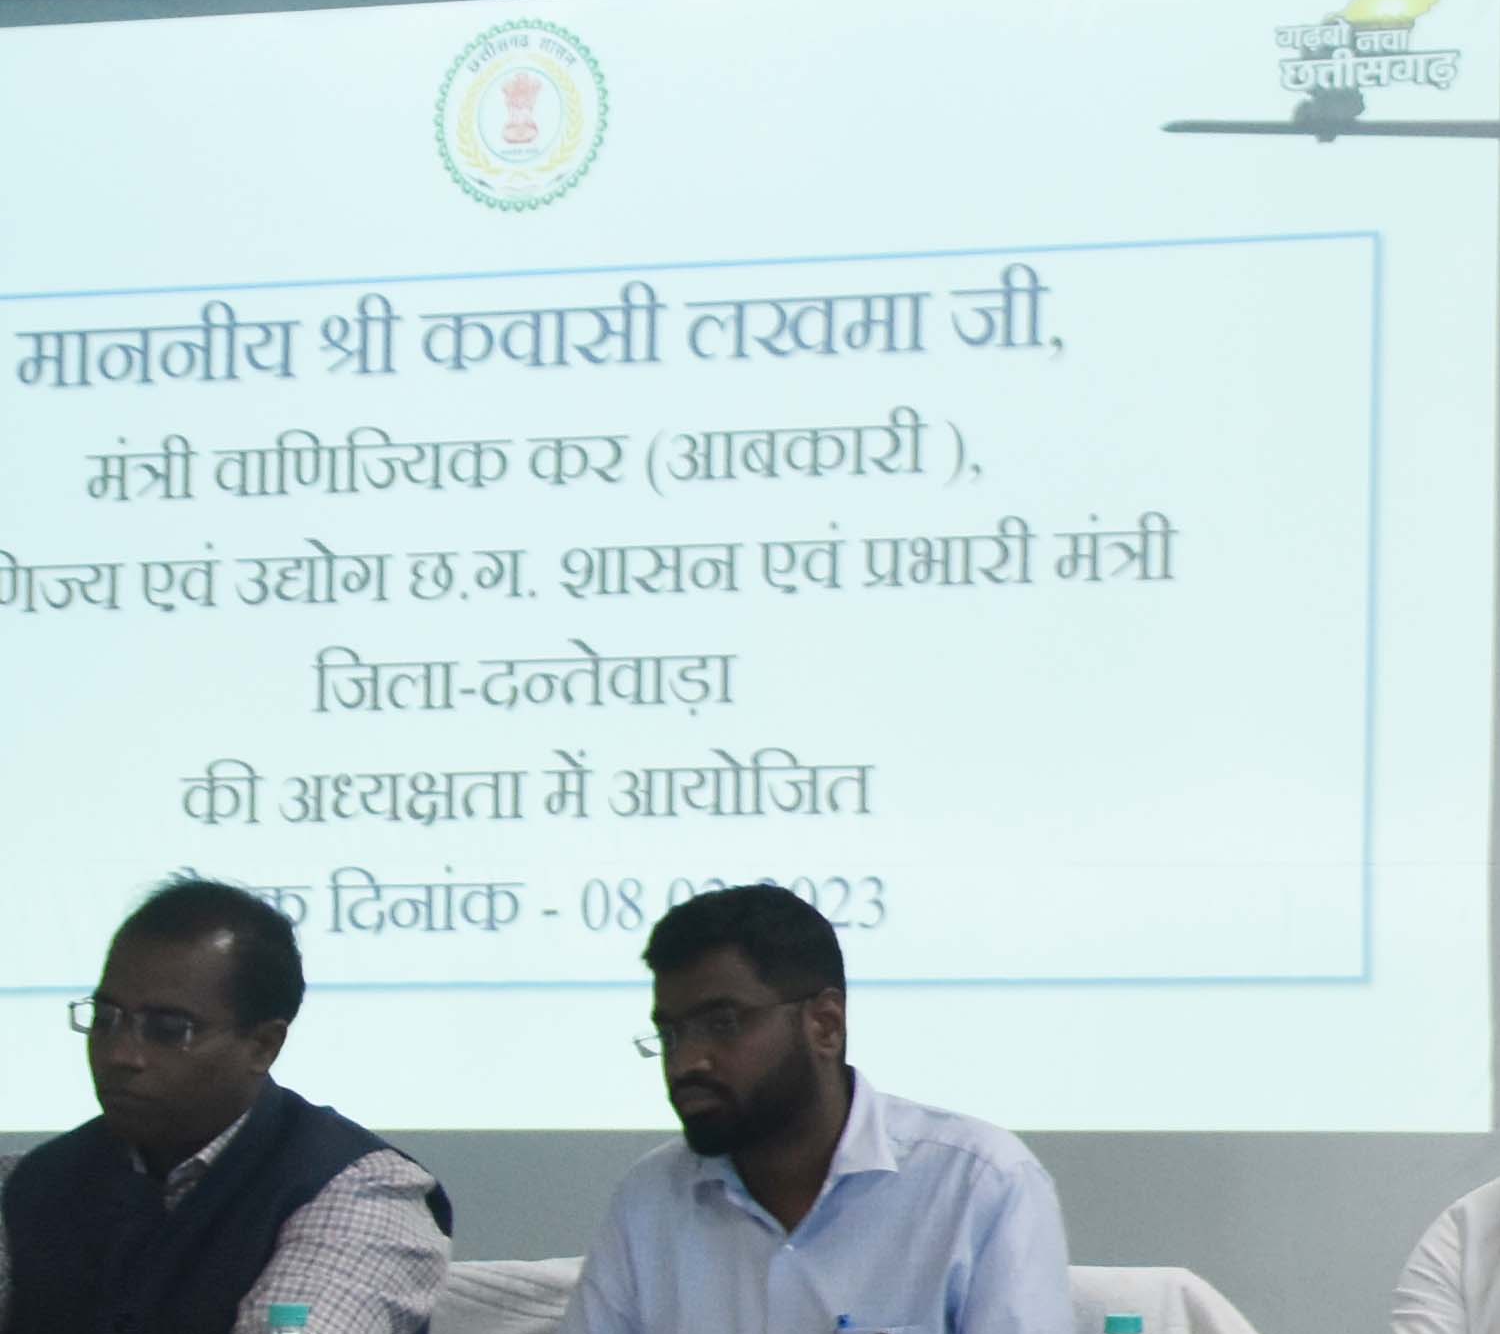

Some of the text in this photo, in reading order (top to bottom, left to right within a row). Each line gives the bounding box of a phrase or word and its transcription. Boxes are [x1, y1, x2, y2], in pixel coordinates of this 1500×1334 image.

[14, 262, 1064, 387] माननीय श्री कवासी लखमा जी,
[86, 434, 198, 501] मंत्री
[212, 426, 512, 497] वाणिज्यिक
[526, 435, 630, 485] कर
[138, 541, 222, 612] एवं
[234, 537, 393, 605] उद्योग
[405, 549, 536, 601] छ.ग.
[559, 541, 743, 599] शासन
[759, 521, 846, 596] एवं
[862, 515, 1037, 589] प्रभारी
[1053, 510, 1179, 583] मंत्री
[310, 638, 738, 716] जिला-दन्तेवाड़ा
[180, 747, 875, 827] की अध्यक्षता में आयोजित
[329, 864, 525, 935] दिनांक
